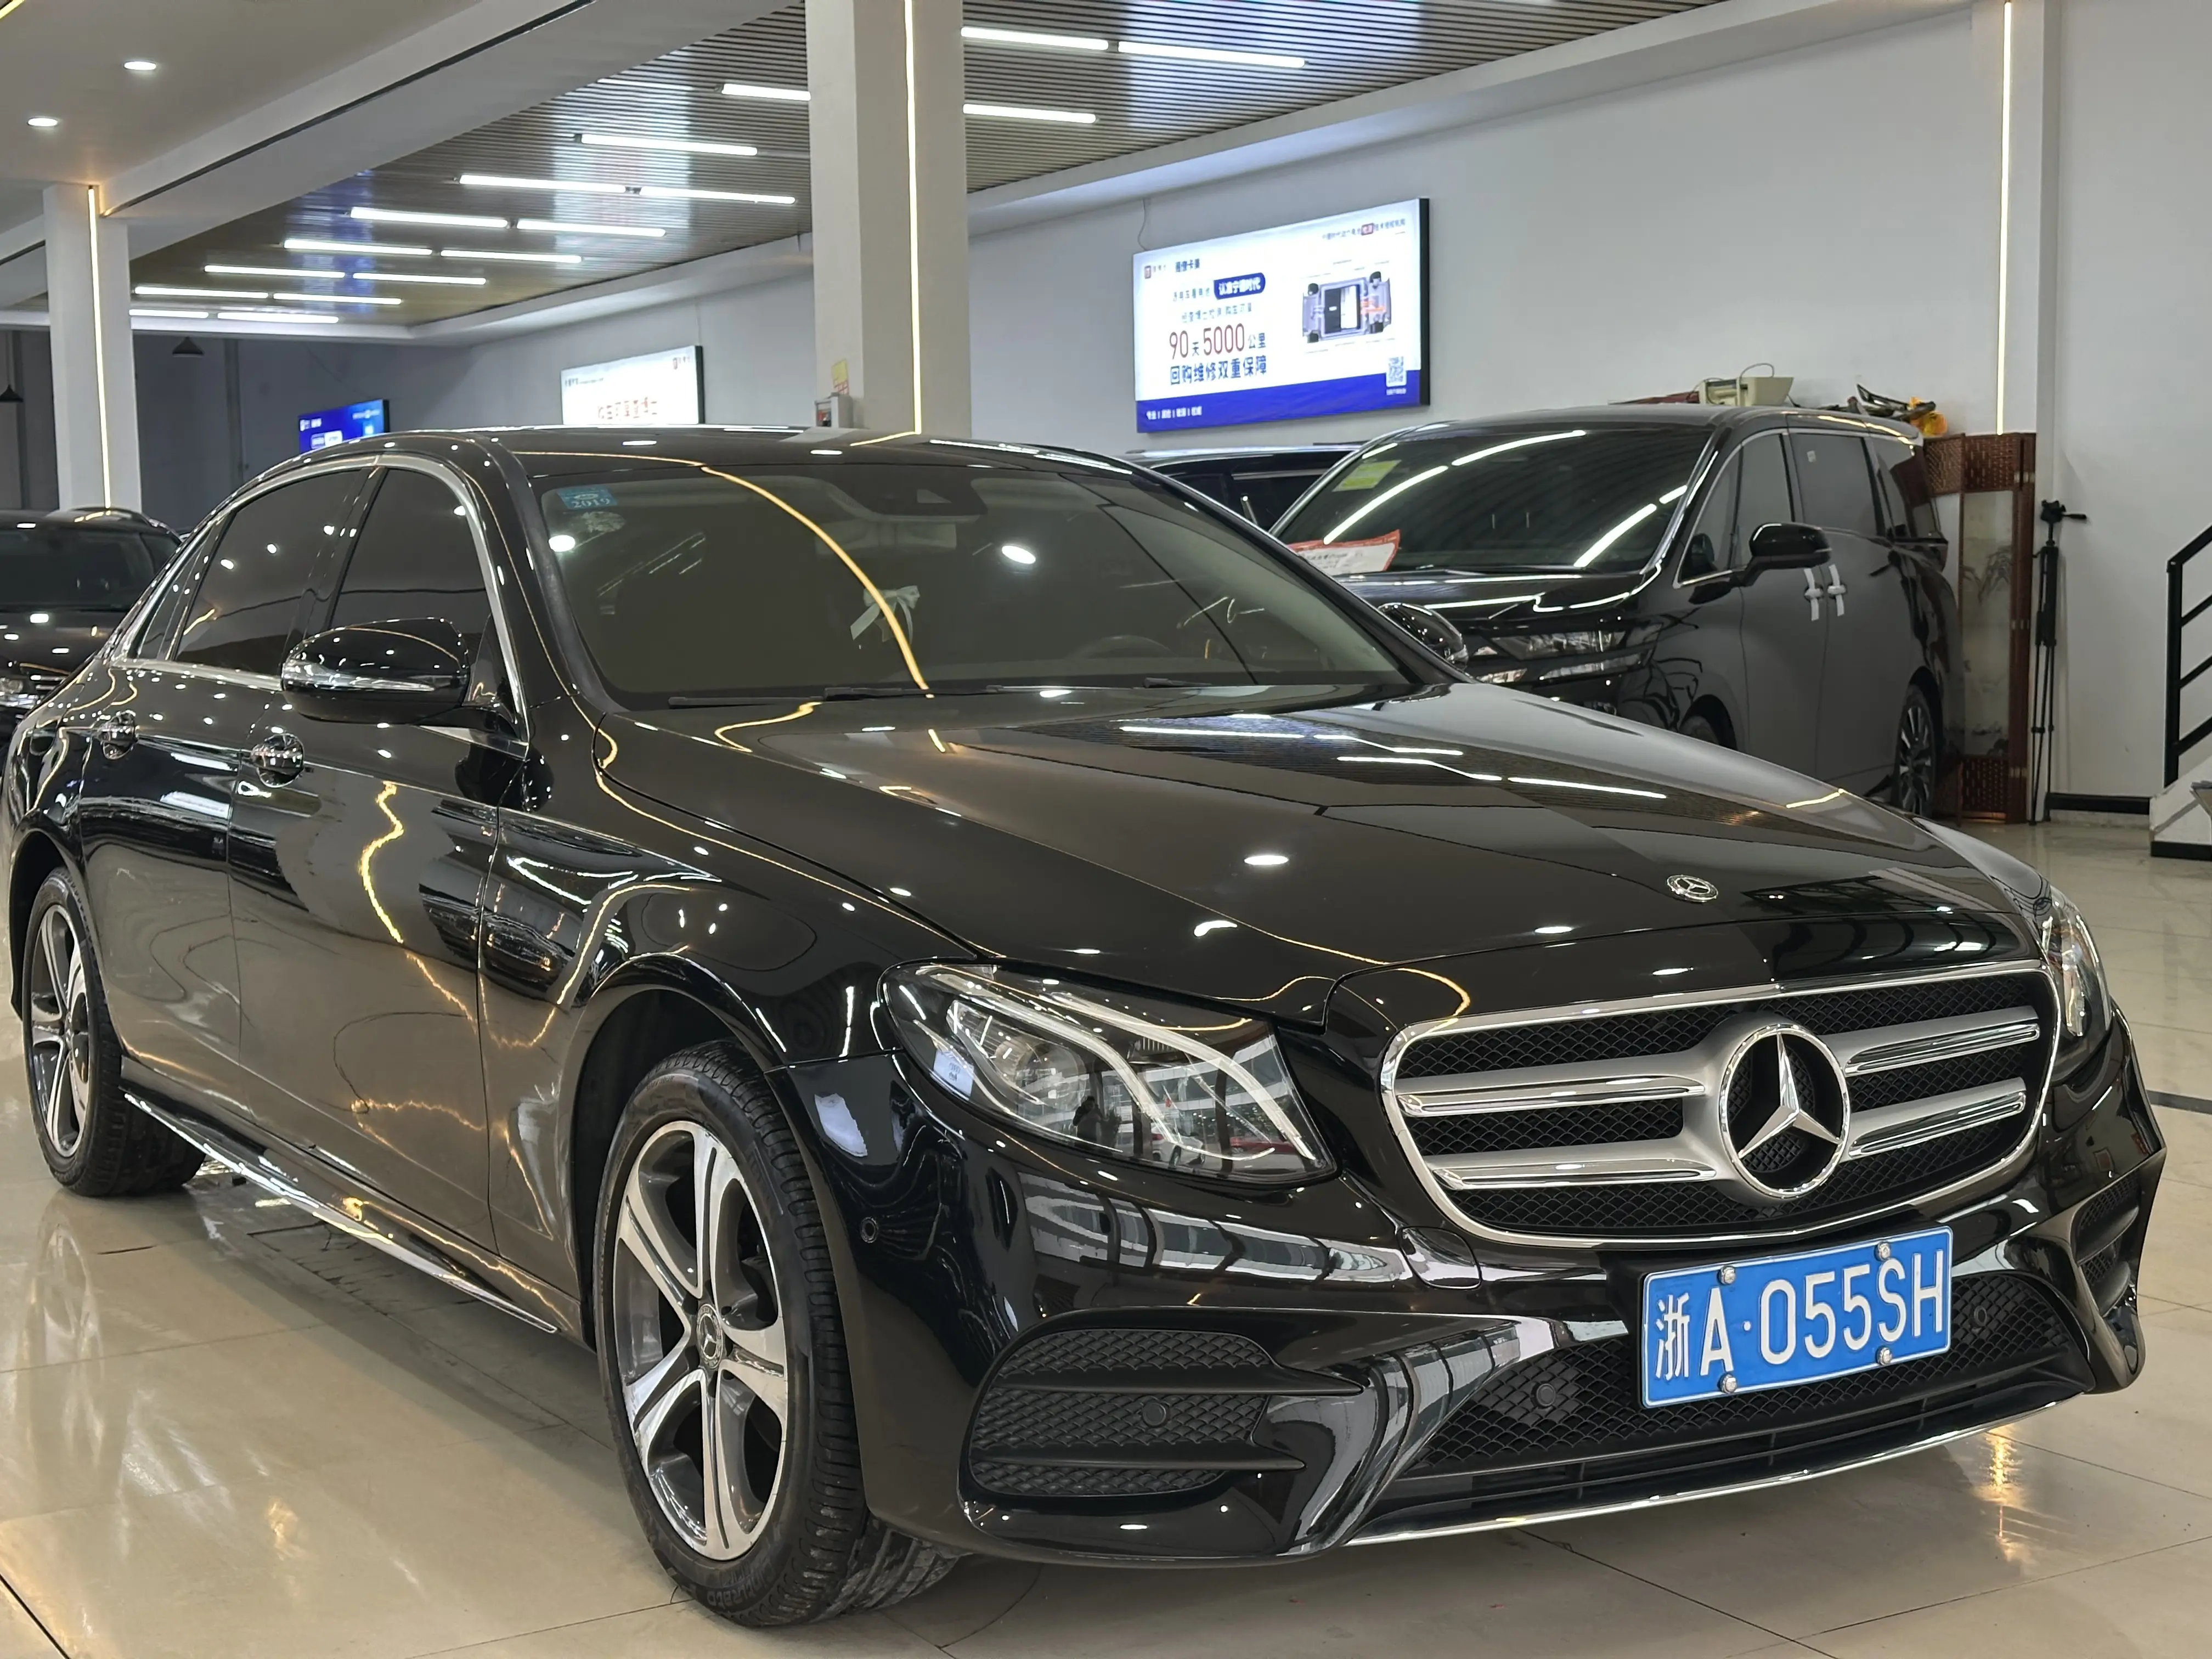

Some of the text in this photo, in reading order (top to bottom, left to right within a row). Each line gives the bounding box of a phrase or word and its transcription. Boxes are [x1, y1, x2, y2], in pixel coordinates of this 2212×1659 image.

[1218, 276, 1261, 296] 认准宁德时代
[1170, 355, 1267, 386] 回购维修双重保障
[571, 498, 610, 508] 2019
